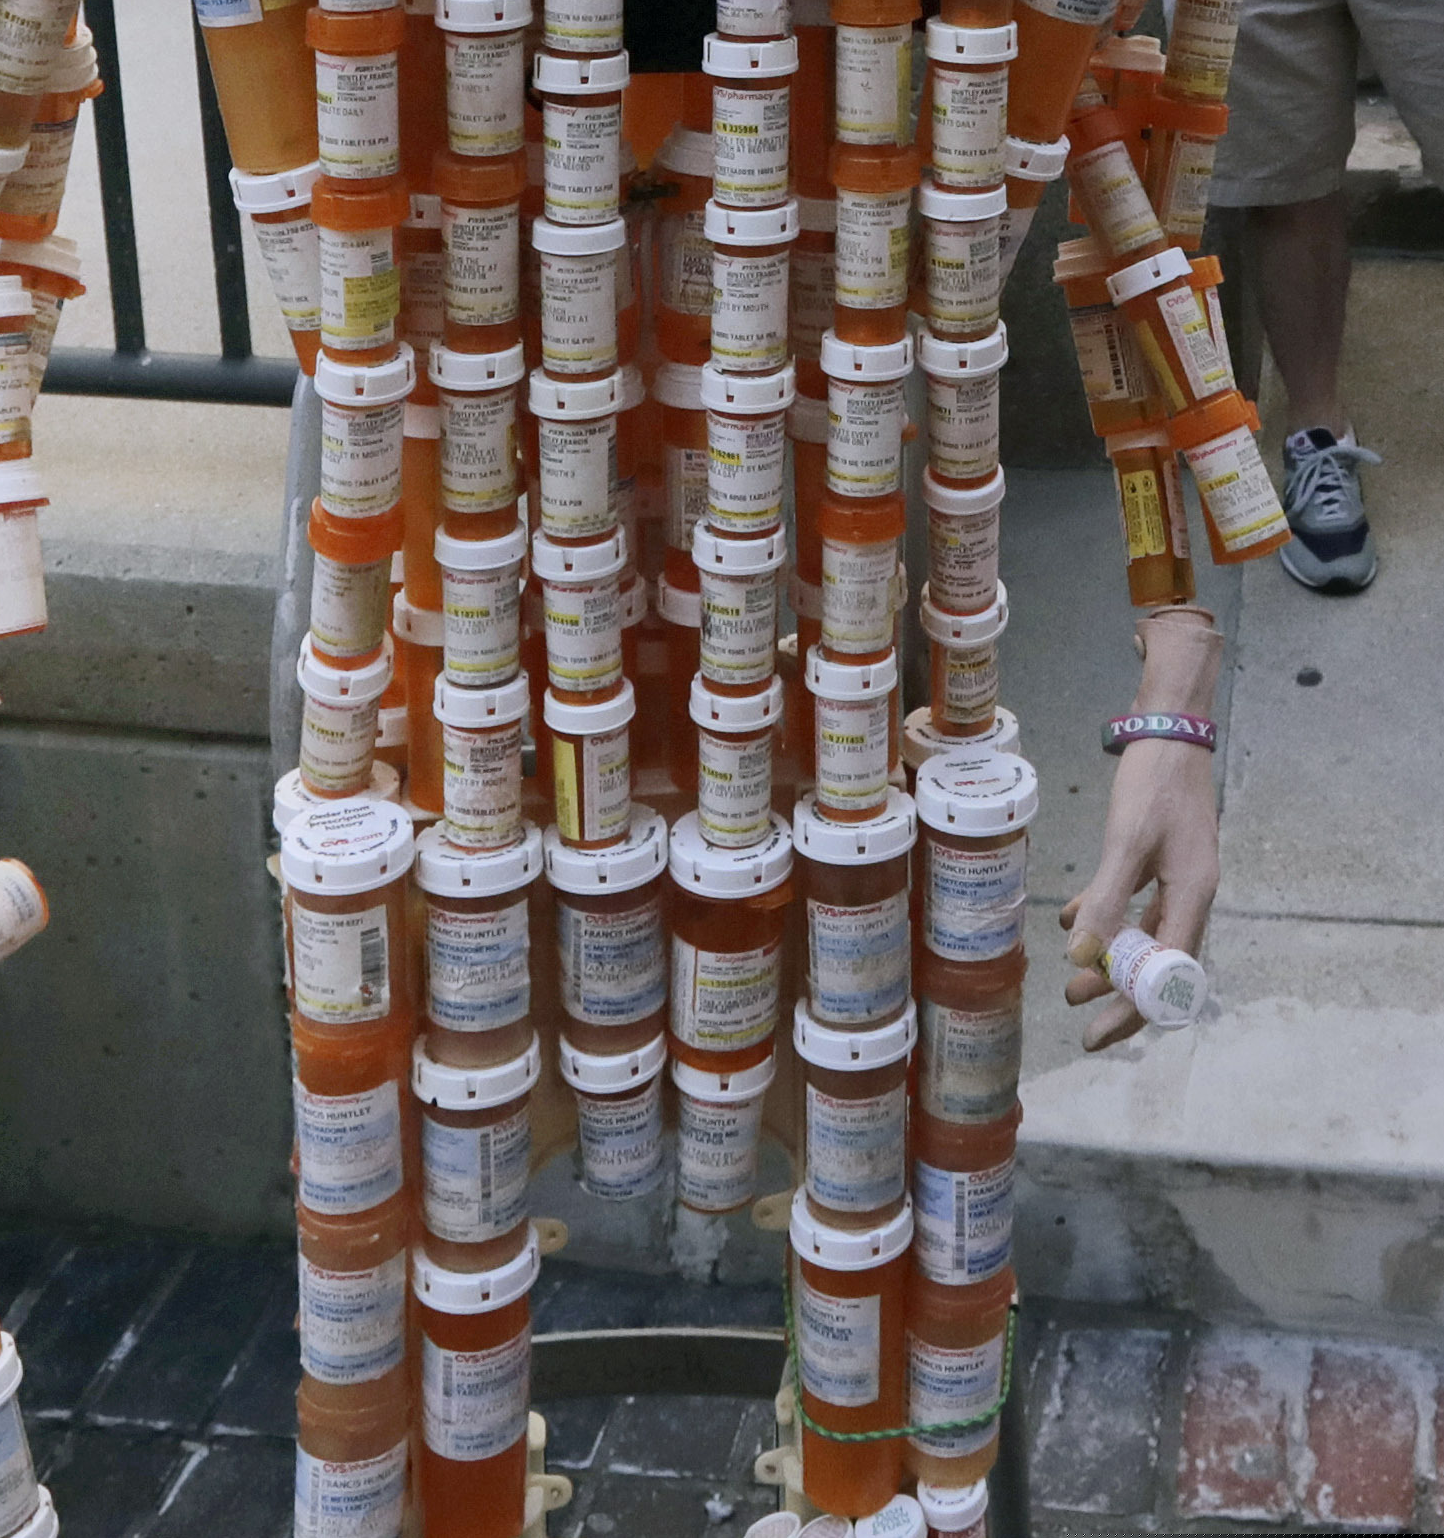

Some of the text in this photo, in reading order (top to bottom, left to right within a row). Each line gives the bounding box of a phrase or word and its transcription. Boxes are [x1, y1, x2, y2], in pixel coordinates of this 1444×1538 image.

[342, 108, 364, 116] DAILY
[743, 302, 769, 311] MOUTH
[1111, 715, 1214, 741] TODAY,
[344, 806, 370, 814] from
[310, 811, 375, 828] prescription
[325, 821, 363, 831] history
[934, 847, 998, 861] CVS/pharmacy
[968, 864, 1008, 875] HUNTLEY
[464, 927, 507, 939] HUNTLEY
[584, 928, 623, 938] FRANCIS
[1170, 974, 1195, 992] PUSH
[1163, 981, 1195, 1001] DOWN
[1166, 992, 1193, 1011] TURN
[327, 1107, 371, 1120] HUNTLEY
[698, 1117, 737, 1127] HUNTLEY
[944, 1360, 985, 1372] HUNTLEY
[323, 1480, 361, 1488] FRANCIS
